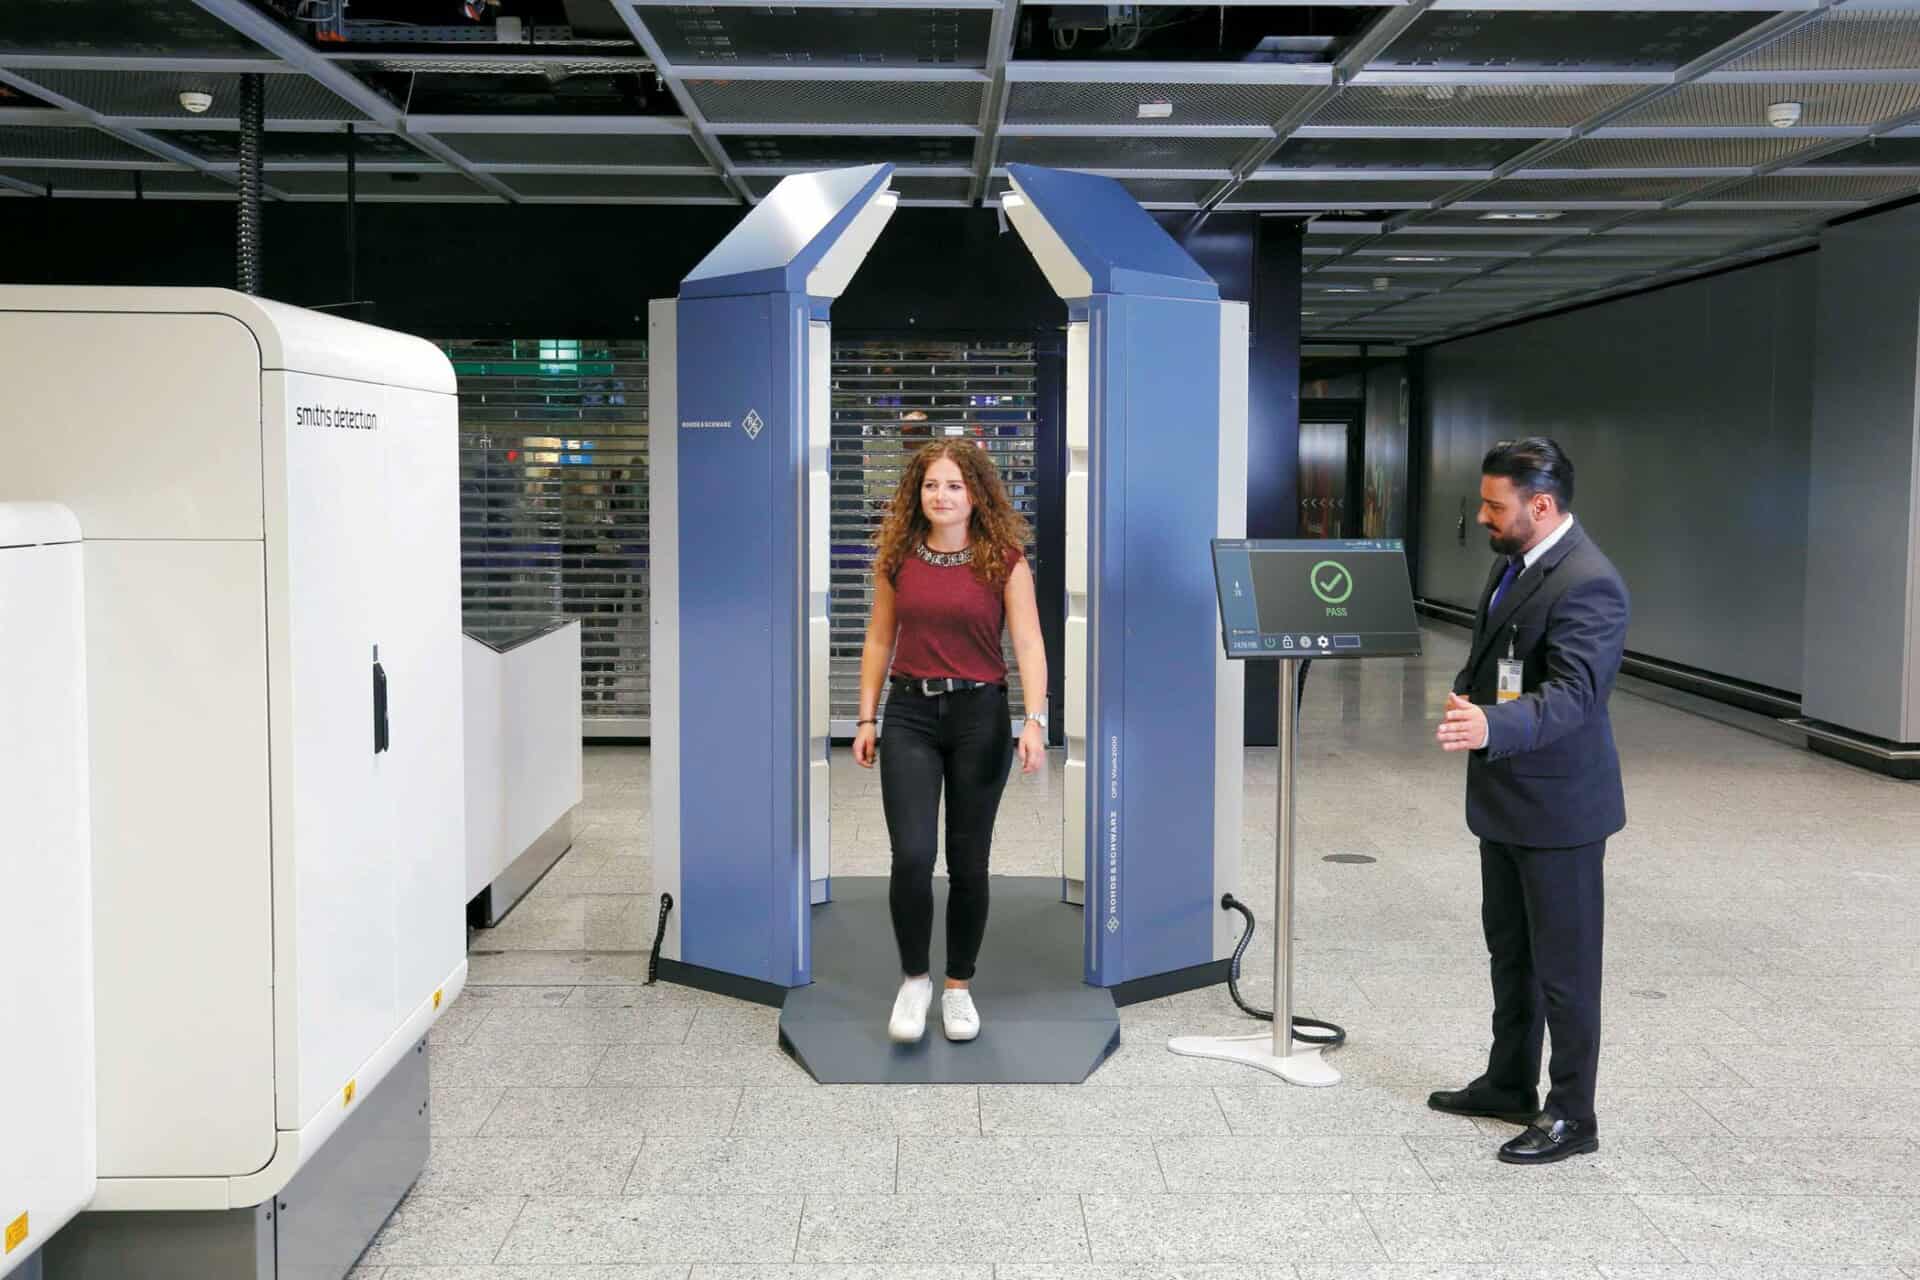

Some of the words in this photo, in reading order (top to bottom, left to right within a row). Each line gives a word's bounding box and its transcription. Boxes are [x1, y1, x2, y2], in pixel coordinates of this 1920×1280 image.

[296, 404, 332, 428] smiths
[333, 406, 378, 431] detection
[1326, 607, 1348, 617] PASS
